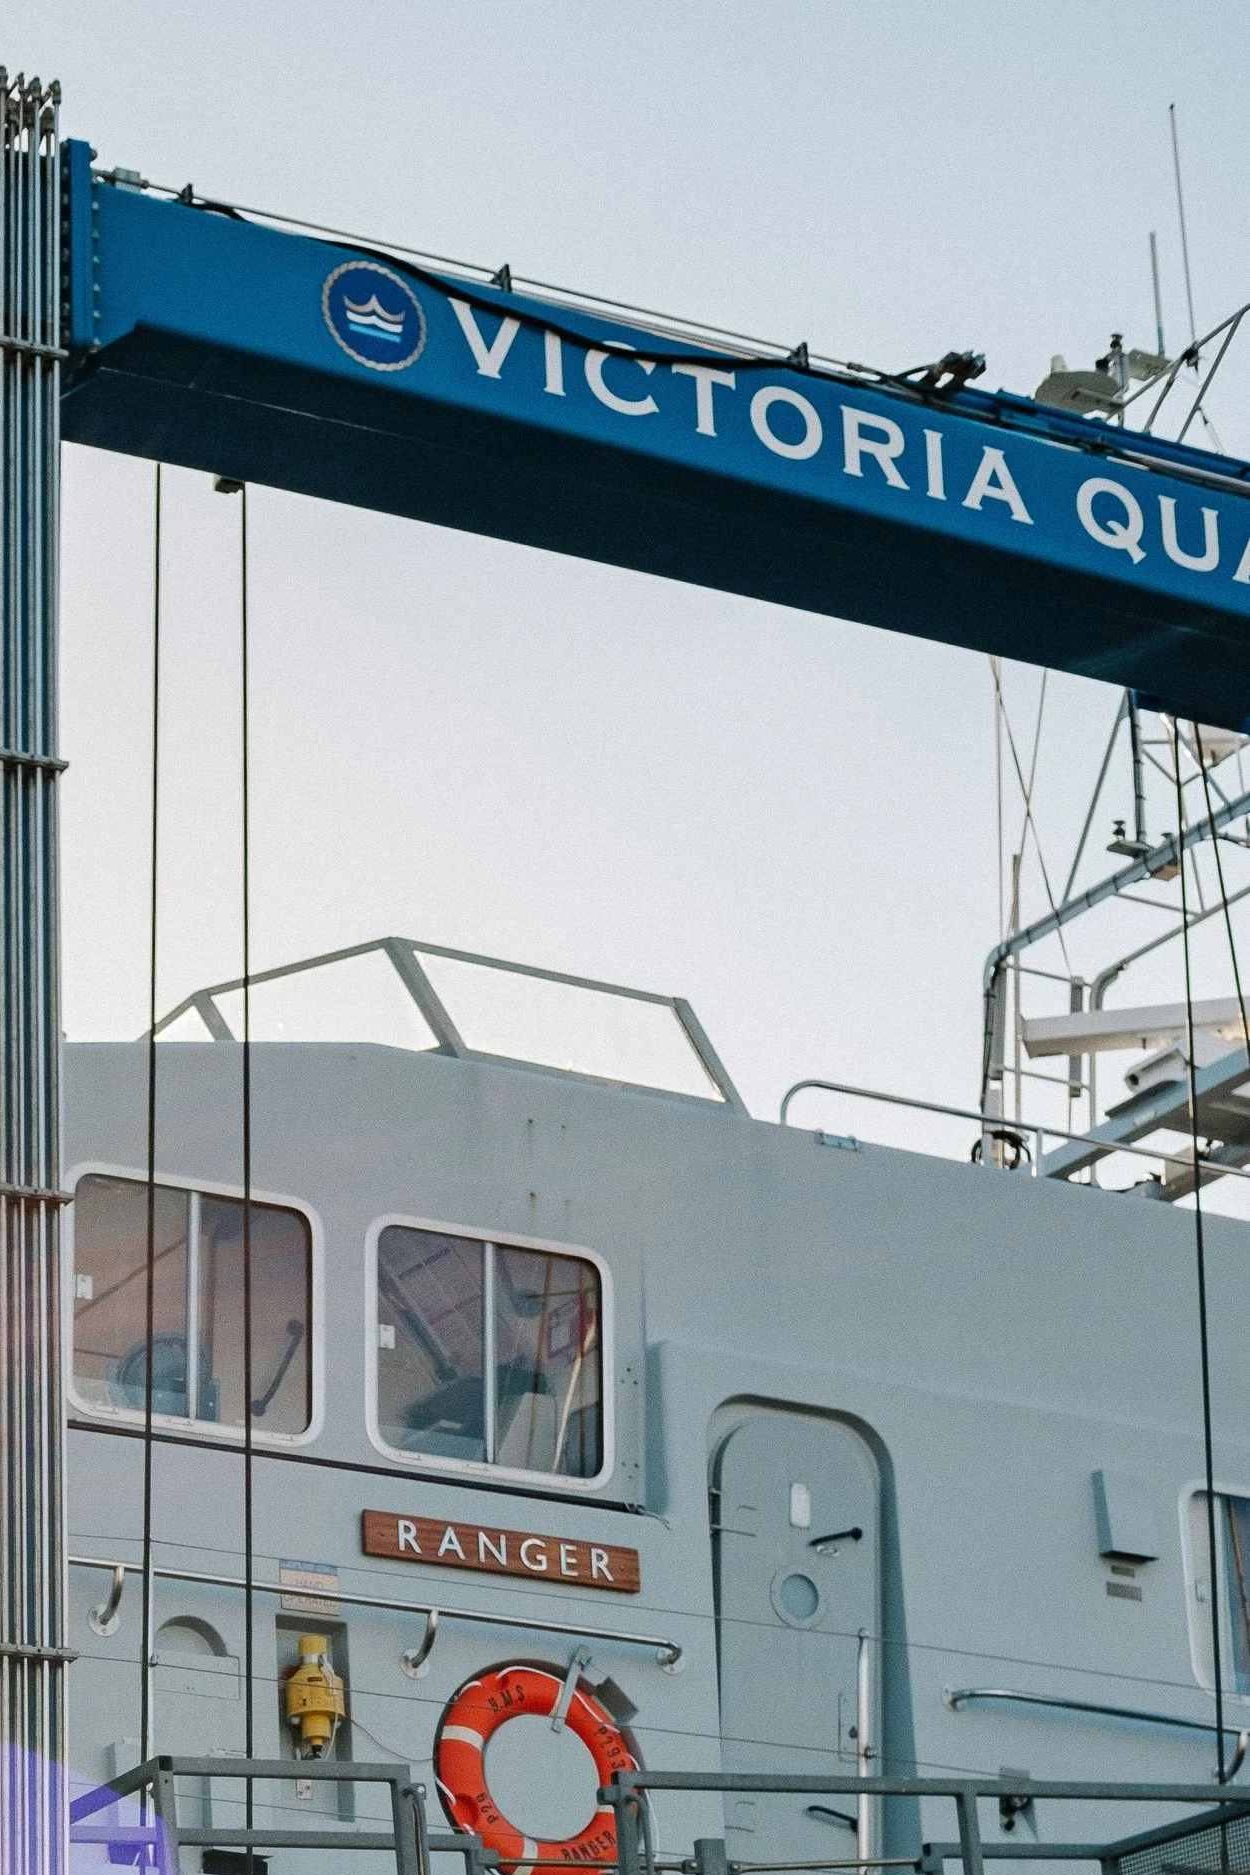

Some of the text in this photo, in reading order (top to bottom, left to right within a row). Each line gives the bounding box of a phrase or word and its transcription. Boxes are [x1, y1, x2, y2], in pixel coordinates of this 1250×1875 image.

[447, 296, 1250, 585] VICTORIA QU
[397, 1518, 615, 1584] RANGER
[596, 1725, 626, 1771] P293
[561, 1830, 617, 1861] RANGER
